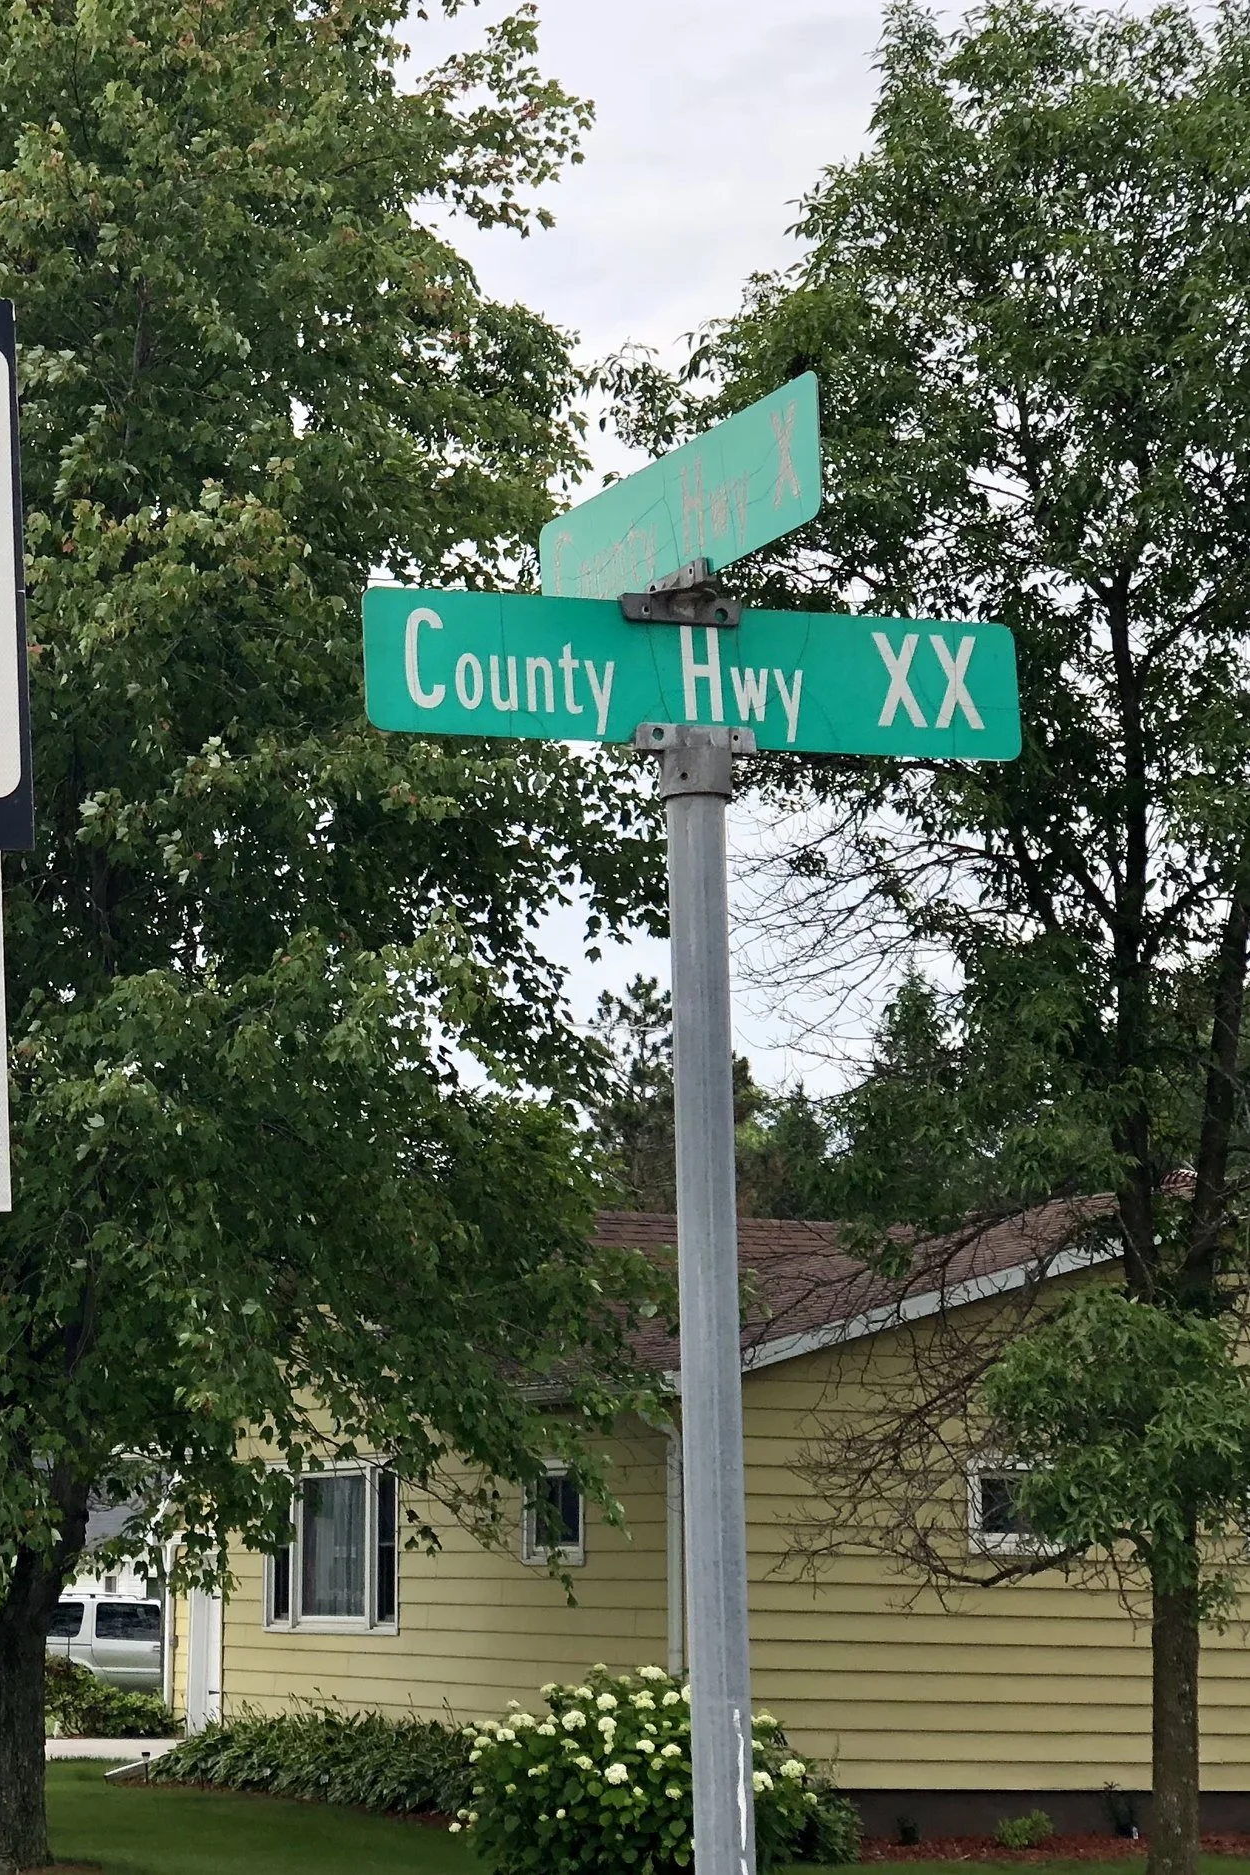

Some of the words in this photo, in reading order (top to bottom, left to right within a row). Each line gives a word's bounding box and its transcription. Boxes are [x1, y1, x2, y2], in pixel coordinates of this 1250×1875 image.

[770, 398, 801, 512] X
[404, 606, 616, 736] County
[678, 625, 804, 743] Hwy
[871, 631, 986, 731] XX
